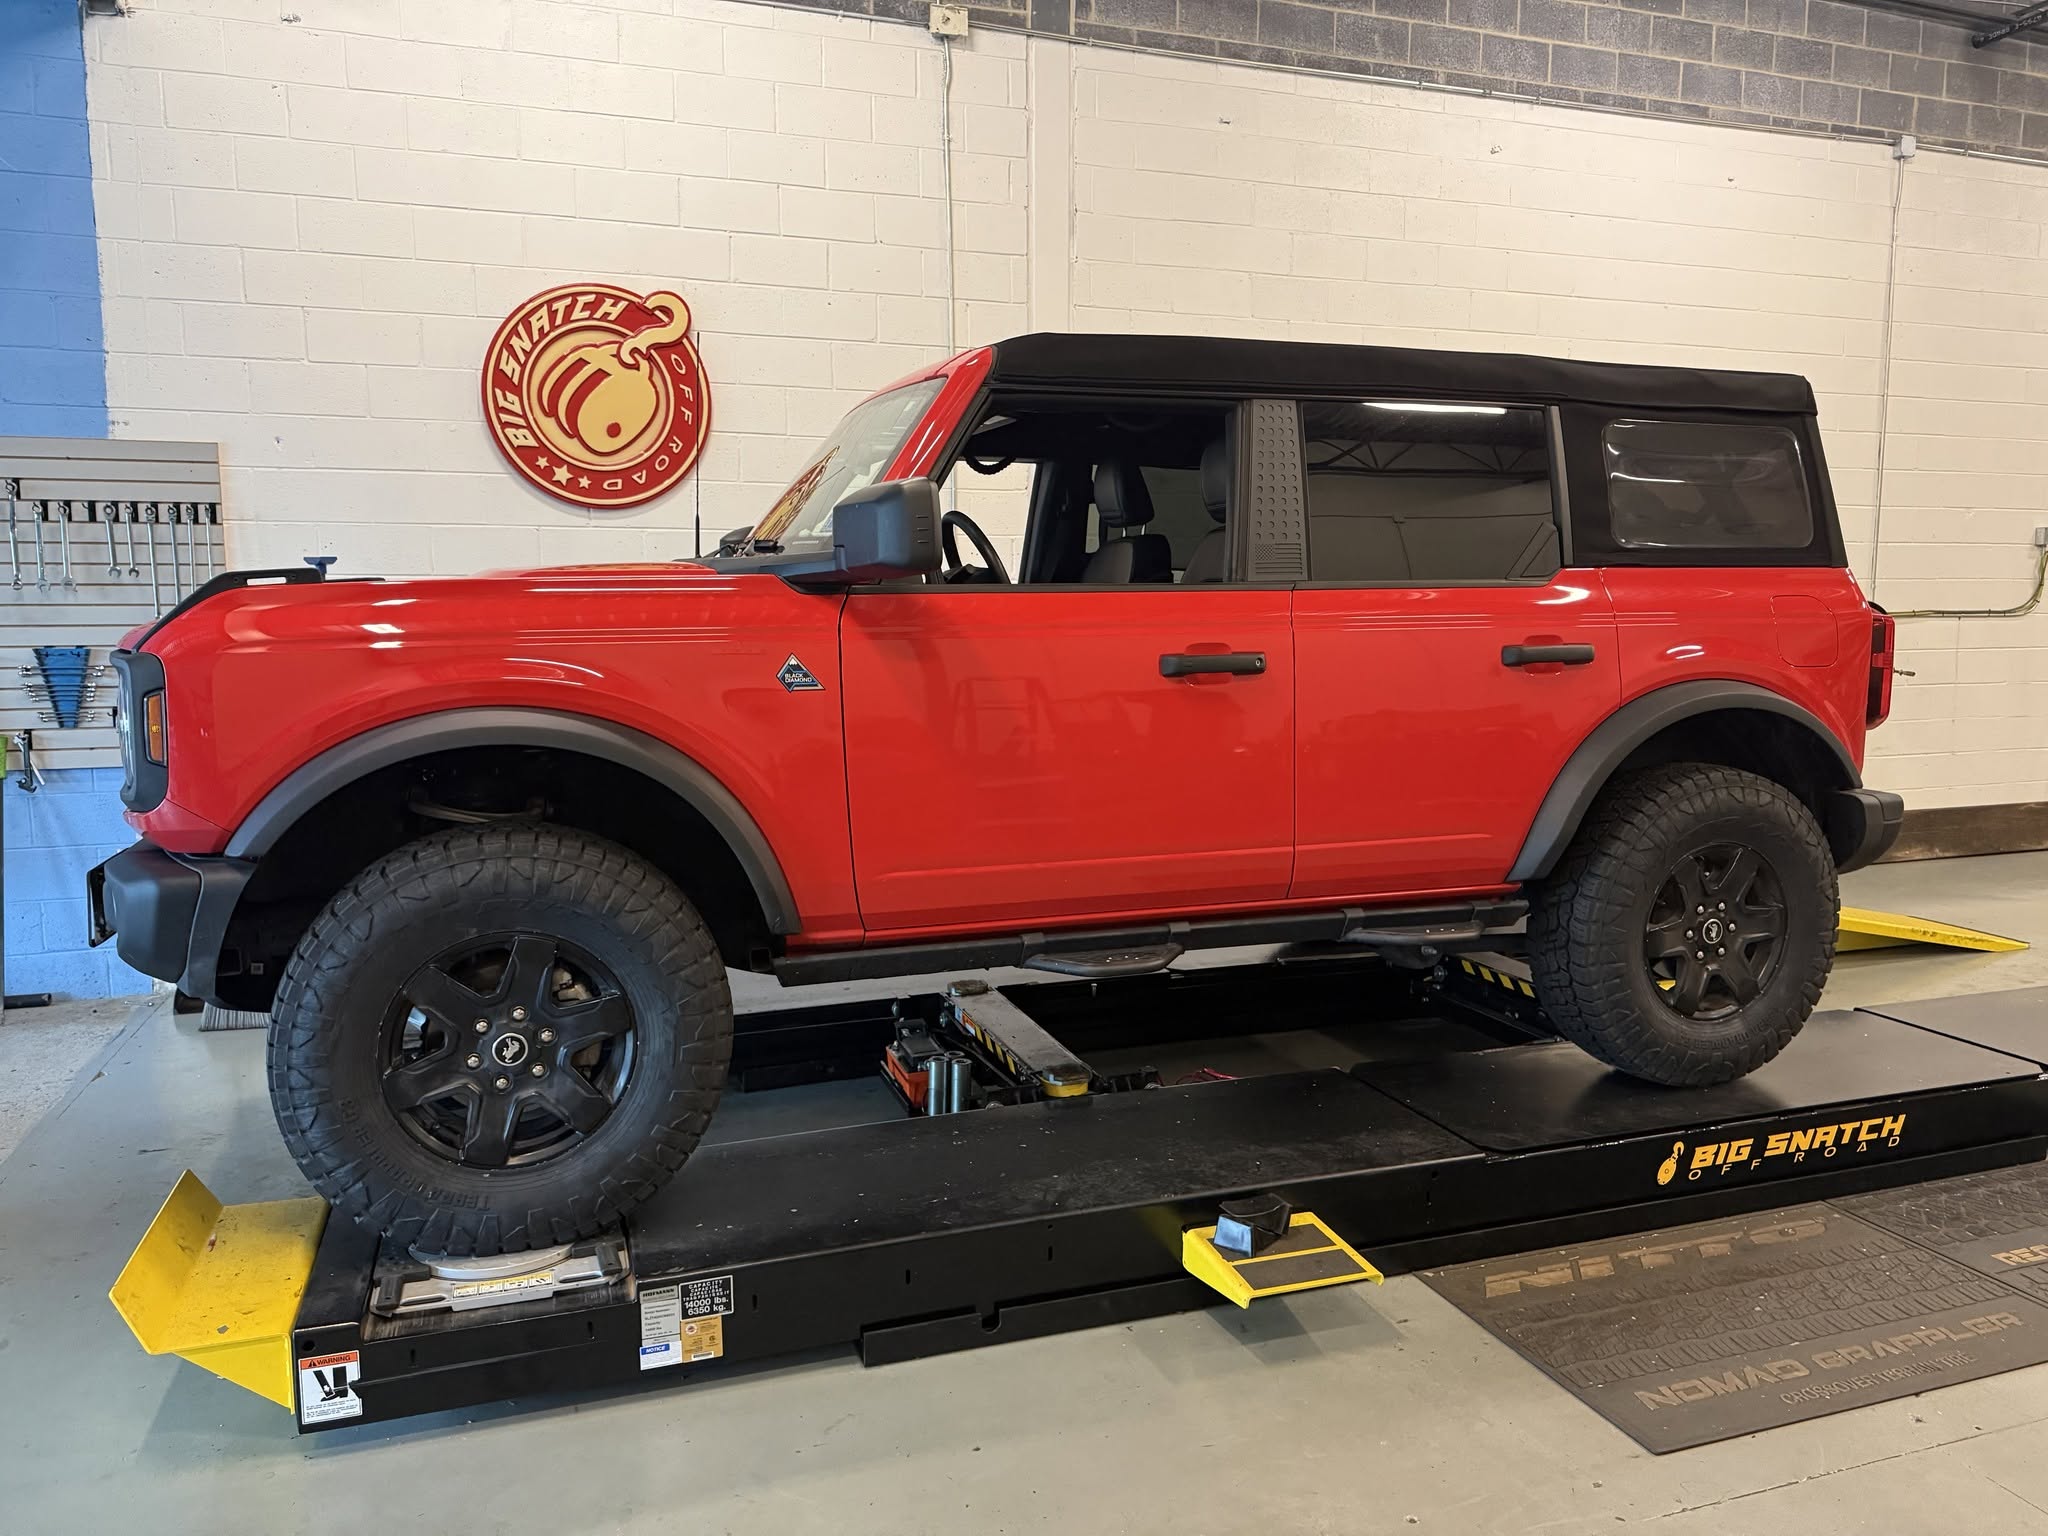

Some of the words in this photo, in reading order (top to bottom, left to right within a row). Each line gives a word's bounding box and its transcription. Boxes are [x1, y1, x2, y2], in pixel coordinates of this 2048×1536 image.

[498, 294, 629, 386] SNATCH
[670, 353, 694, 425] OFF
[495, 387, 539, 449] BIG
[602, 435, 684, 491] ROAD
[1688, 1158, 1761, 1181] OFF
[1794, 1136, 1900, 1163] ROAD
[1690, 1138, 1754, 1169] BIG
[1764, 1114, 1906, 1157] SNATCH
[684, 1298, 711, 1309] 14000
[714, 1296, 729, 1304] lbs.
[688, 1280, 723, 1290] CAPACITY
[688, 1305, 710, 1316] 6350
[713, 1304, 726, 1312] kg.
[317, 1355, 351, 1366] WARNING
[646, 1345, 666, 1353] NOTICE
[1634, 1357, 1811, 1411] NOMAD
[1811, 1311, 2023, 1369] GRAPPLER
[1780, 1372, 1880, 1405] CROSSOVER
[1873, 1357, 1944, 1384] TERRAIN
